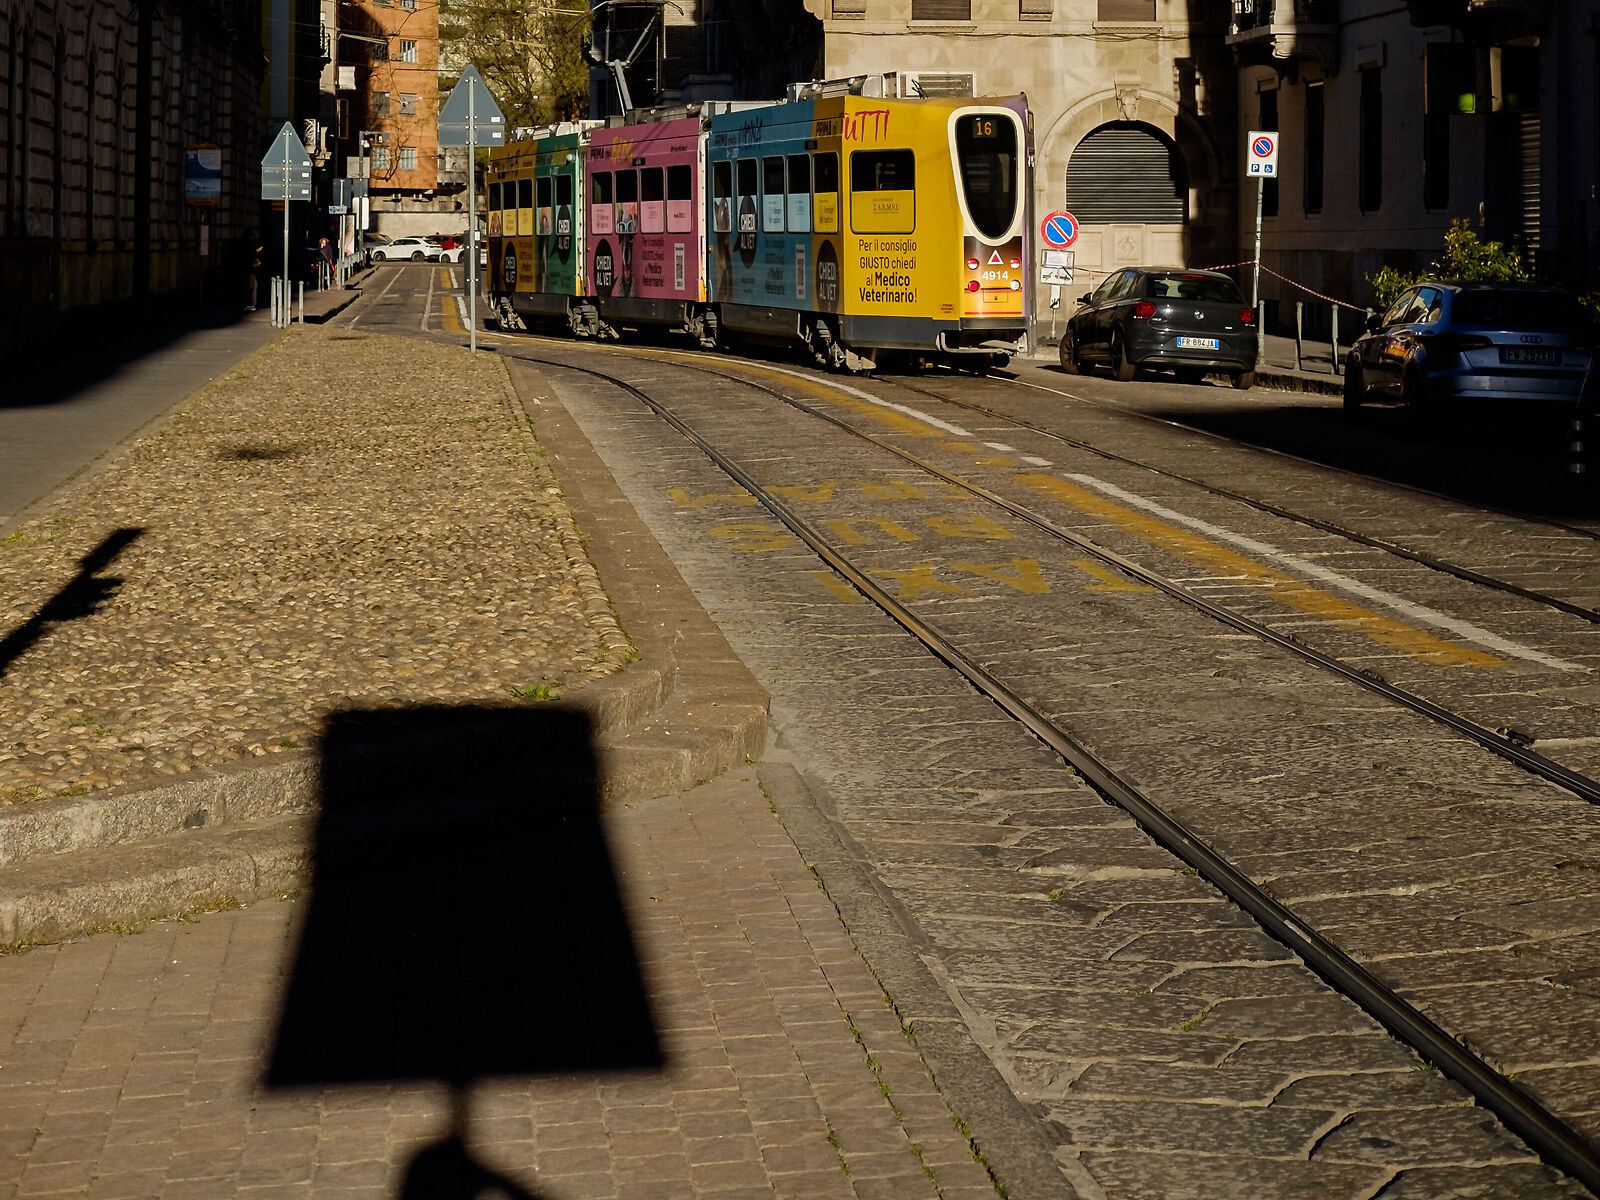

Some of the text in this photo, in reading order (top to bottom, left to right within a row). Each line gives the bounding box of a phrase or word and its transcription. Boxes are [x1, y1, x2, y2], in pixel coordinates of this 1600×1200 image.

[976, 121, 992, 136] 16
[859, 239, 917, 255] Per il consiglio
[596, 255, 612, 271] CHIEDI
[859, 256, 917, 269] GIUSTO chiedi
[818, 261, 837, 280] CHIEDI
[982, 270, 1009, 281] 4914
[602, 272, 612, 286] VET
[866, 272, 910, 287] al Medico
[827, 283, 837, 301] VET
[859, 287, 918, 303] Veterinario!
